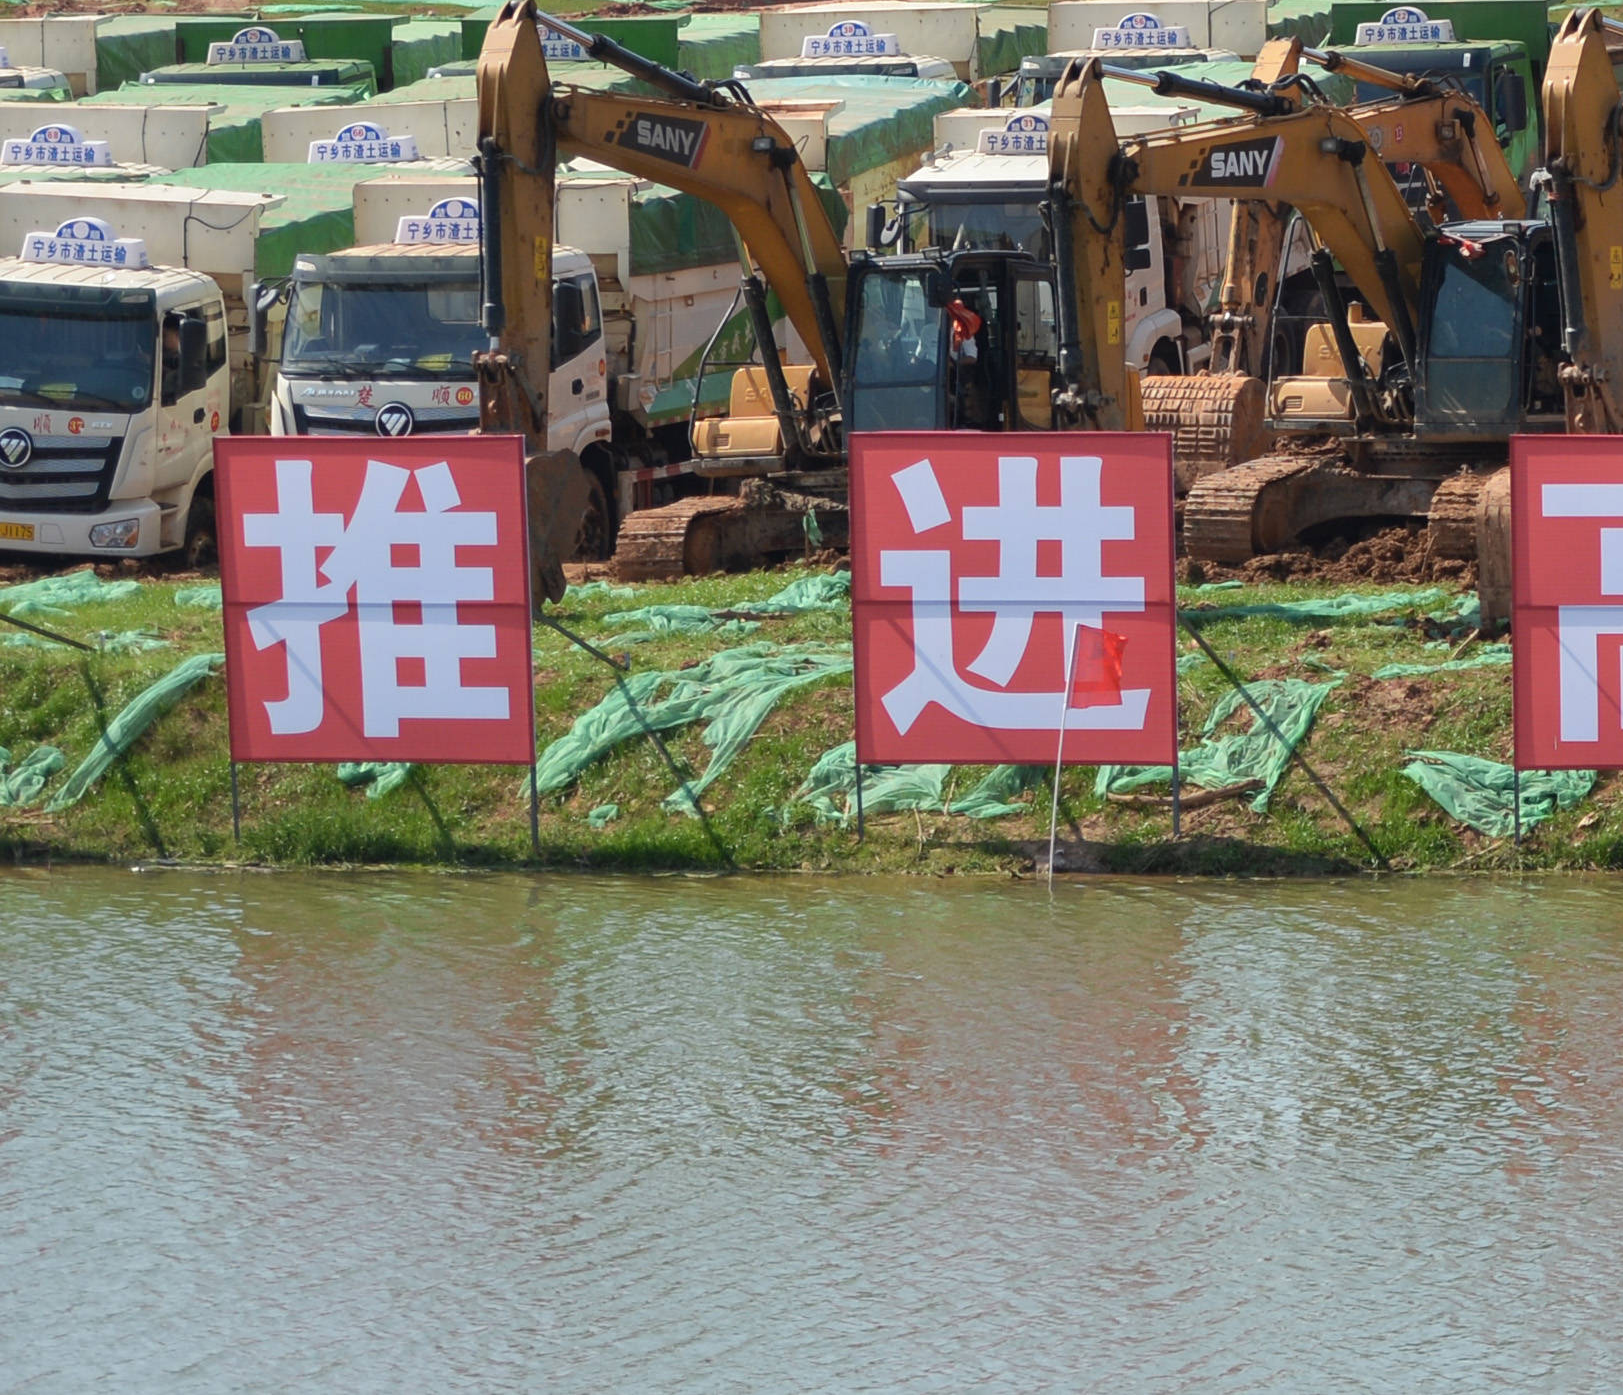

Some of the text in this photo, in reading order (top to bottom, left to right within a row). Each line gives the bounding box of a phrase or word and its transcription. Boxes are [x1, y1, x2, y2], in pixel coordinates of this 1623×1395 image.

[1101, 31, 1177, 46] 宁乡市渣土运输
[1365, 26, 1440, 42] 宁乡市渣土运输
[216, 45, 291, 61] 宁乡市渣土运输
[811, 39, 886, 54] 宁乡市渣土运输
[637, 120, 694, 156] SANY
[11, 146, 94, 163] 宁乡市渣土运输
[317, 142, 400, 160] 宁乡市渣土运输
[1211, 150, 1268, 178] SANY
[33, 239, 127, 264] 宁乡市渣土运输
[355, 385, 376, 408] 楚
[243, 460, 509, 737] 推
[881, 456, 1151, 736] 进
